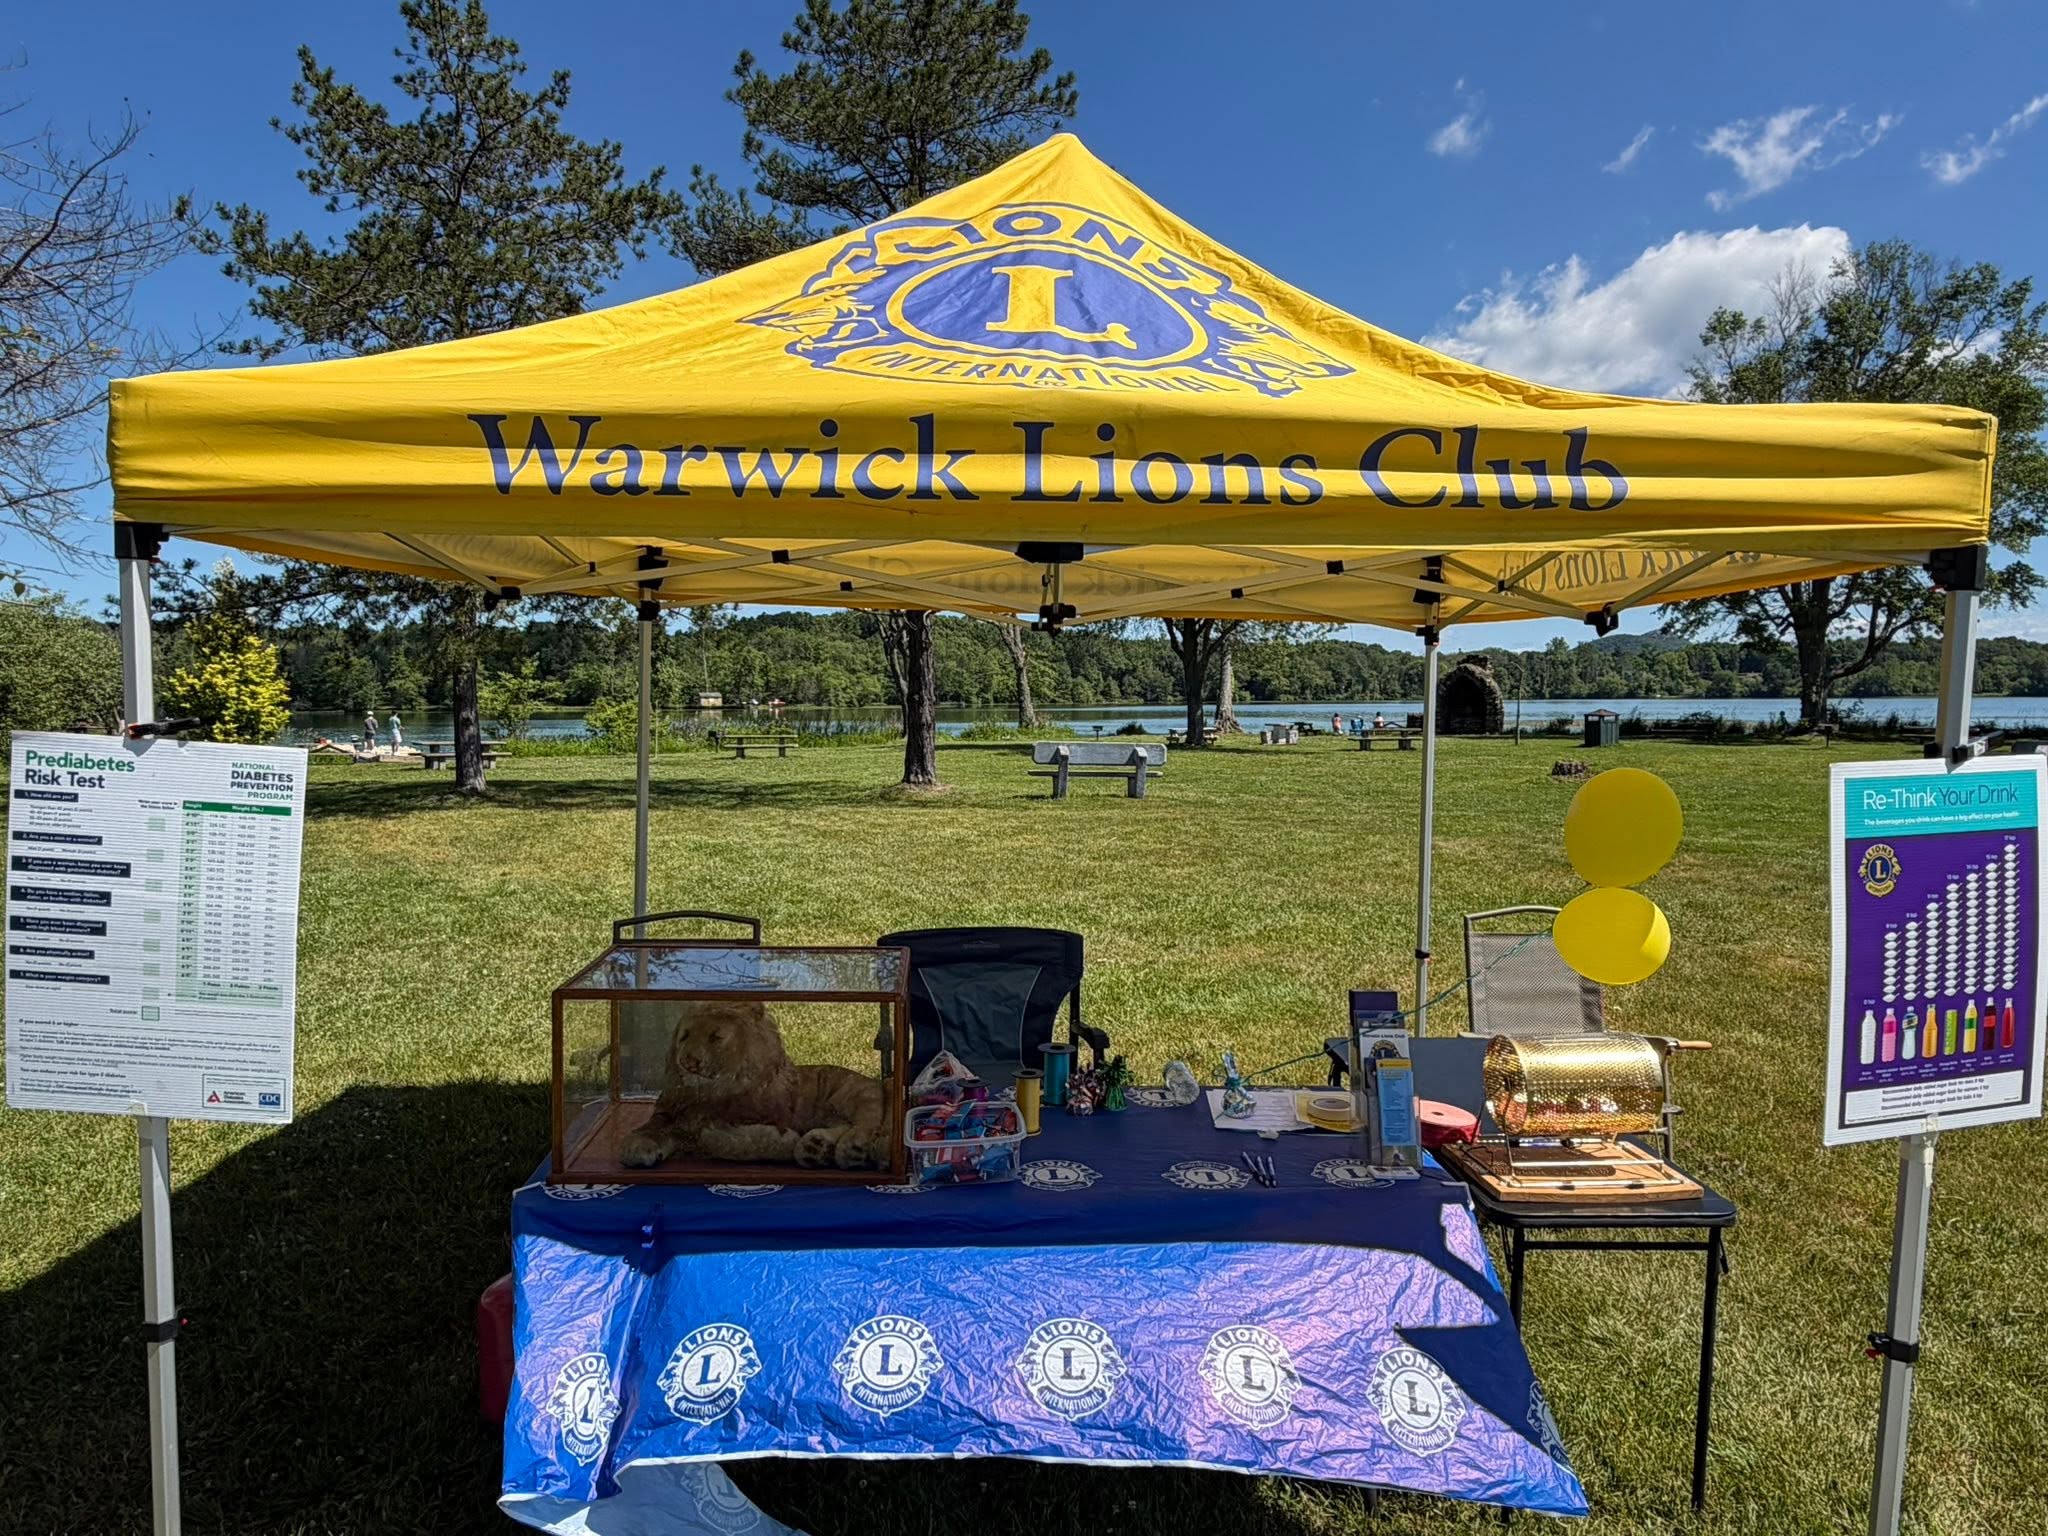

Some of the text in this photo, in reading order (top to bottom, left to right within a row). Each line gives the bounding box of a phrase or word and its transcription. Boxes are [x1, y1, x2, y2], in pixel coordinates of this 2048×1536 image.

[894, 211, 1203, 281] LIONS
[986, 265, 1136, 350] L
[867, 350, 1240, 393] INTERNATIONAL
[467, 413, 1628, 512] Warwick Lions Club
[25, 750, 135, 772] Prediabetes
[232, 762, 275, 770] NATIONAL
[25, 769, 105, 788] Risk Test
[231, 781, 293, 791] PREVENTION
[232, 770, 293, 782] DIABETES
[248, 792, 293, 800] PROGRAM
[1864, 784, 2018, 809] Re-Think Your Drink
[1867, 846, 1892, 857] LIONS
[1875, 860, 1886, 879] L
[260, 1094, 280, 1102] CDC
[686, 1325, 744, 1353] LIONS
[864, 1318, 924, 1340] LIONS
[1040, 1321, 1101, 1343] LIONS
[1218, 1329, 1279, 1355] LIONS
[696, 1353, 722, 1386] L
[876, 1344, 903, 1376] L
[1059, 1347, 1086, 1381] L
[1239, 1355, 1267, 1391] L
[1387, 1353, 1444, 1380] LIONS
[676, 1391, 736, 1417] INTERNATIONAL
[855, 1386, 918, 1406] INTERNATIONAL
[1040, 1389, 1103, 1411] INTERNATIONAL
[1224, 1395, 1284, 1422] INTERNATIONAL
[1404, 1380, 1432, 1418] L
[1391, 1422, 1449, 1448] INTERNATIONAL
